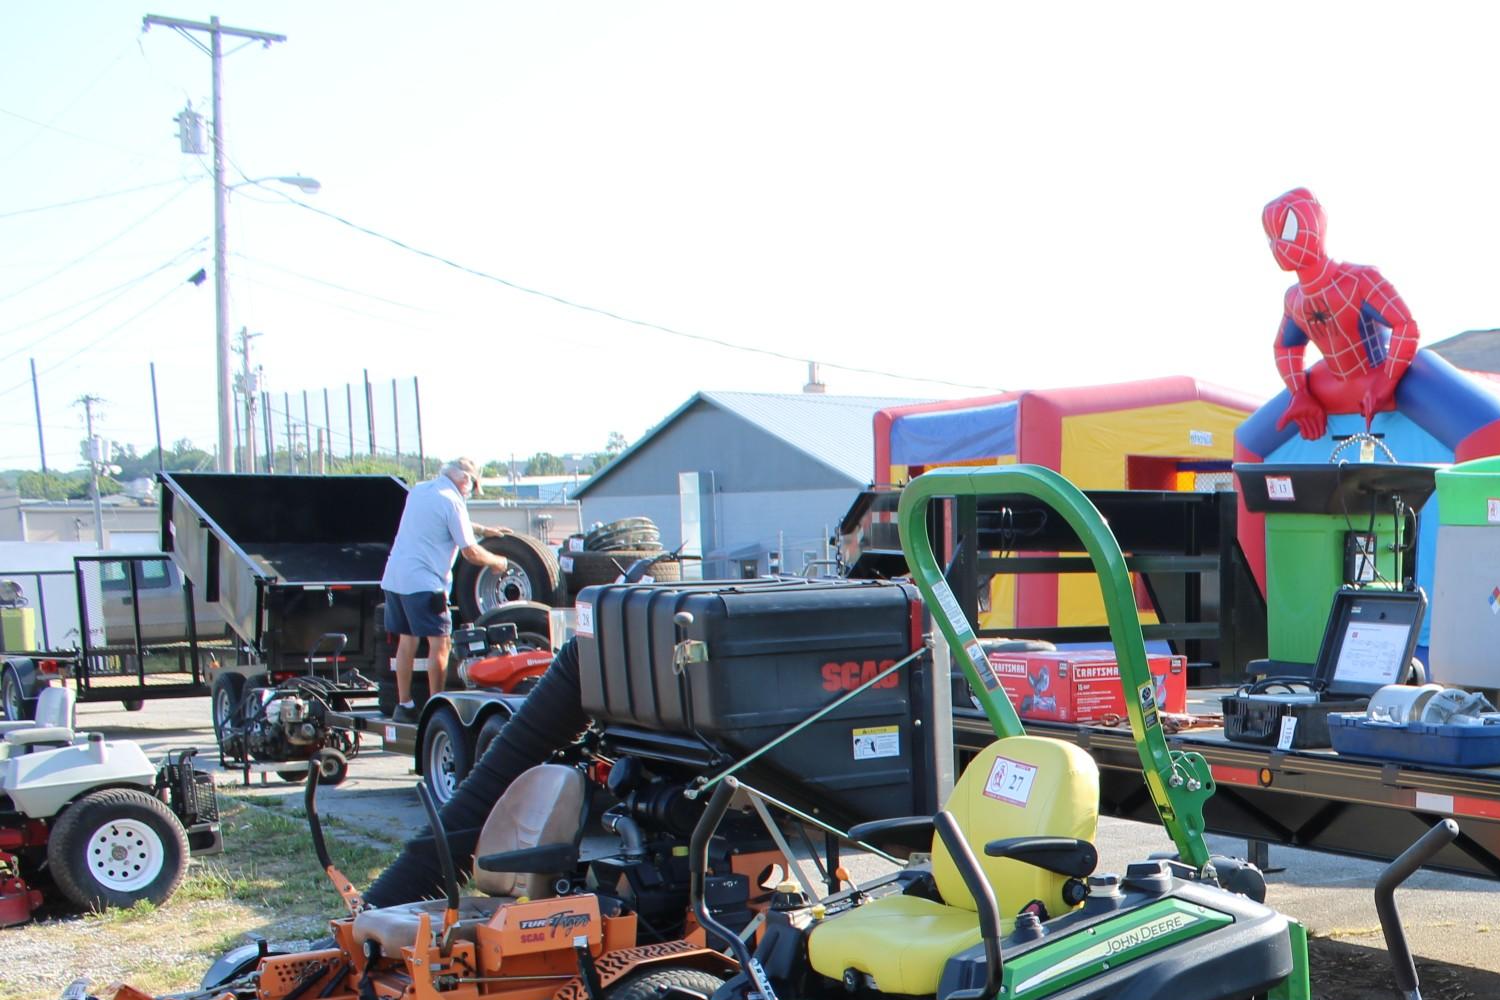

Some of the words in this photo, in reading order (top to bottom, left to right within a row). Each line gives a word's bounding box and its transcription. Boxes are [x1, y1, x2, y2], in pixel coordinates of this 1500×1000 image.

[581, 613, 590, 627] 28
[821, 659, 899, 692] SCAG
[1076, 666, 1119, 678] CRAFTSMA
[1008, 774, 1024, 792] 27
[520, 932, 545, 944] SCAG
[1104, 932, 1140, 955] JOHN
[1140, 916, 1183, 939] DEERE
